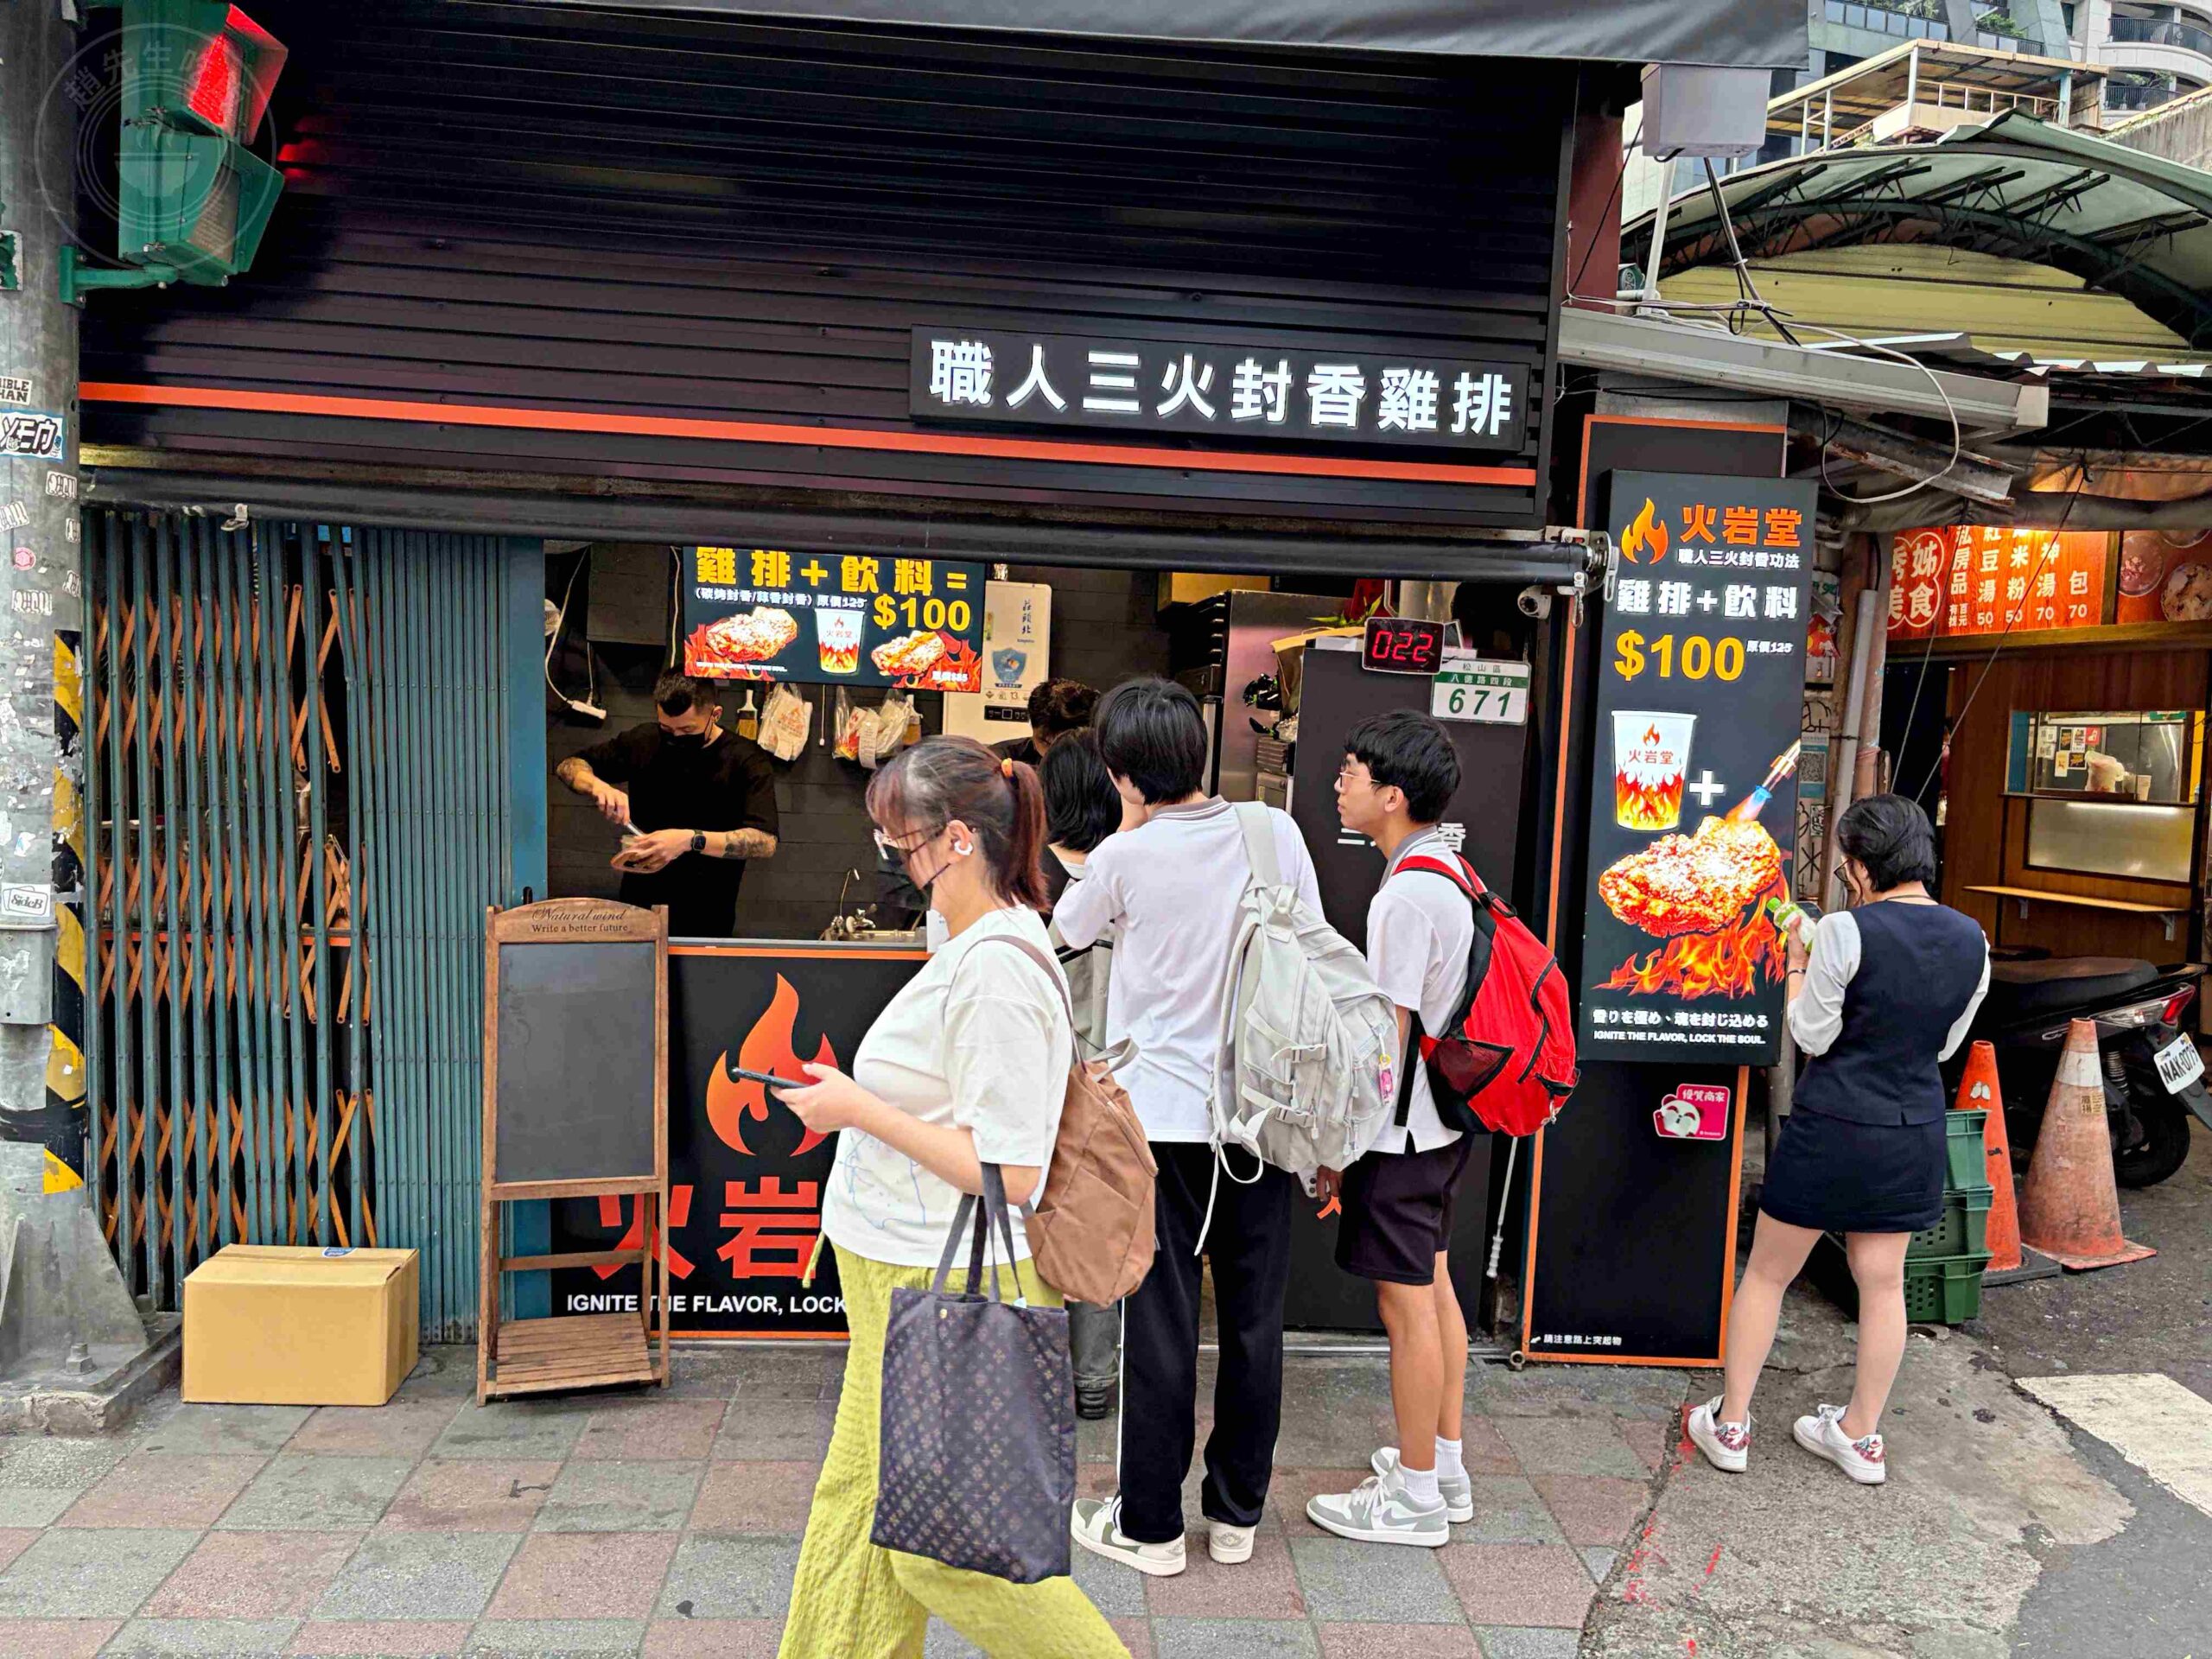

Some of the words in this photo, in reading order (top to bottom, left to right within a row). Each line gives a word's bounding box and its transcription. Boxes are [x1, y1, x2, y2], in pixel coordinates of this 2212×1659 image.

[929, 340, 1513, 435] 職人三火封香雞排
[1680, 504, 1802, 547] 火岩堂
[873, 593, 971, 632] $100
[1977, 611, 1993, 626] 50
[2005, 609, 2023, 623] 50
[2036, 606, 2055, 621] 70
[2069, 604, 2088, 620] 70
[1372, 629, 1433, 663] 022
[1614, 629, 1745, 682] $100
[1451, 673, 1513, 687] 八德路四段
[1448, 688, 1511, 717] 671
[1628, 748, 1674, 765] 火岩堂
[593, 909, 626, 921] wind
[531, 924, 558, 933] Write
[569, 923, 597, 932] better
[600, 923, 628, 932] future
[1593, 1030, 1626, 1040] IGNITE
[1627, 1032, 1646, 1041] THE
[1648, 1033, 1688, 1044] FLAVOR,
[1689, 1034, 1716, 1043] LOCK
[1716, 1035, 1736, 1044] THE
[1737, 1035, 1766, 1045] SOUL.
[1682, 1089, 1726, 1103] 優質商家
[567, 1294, 638, 1312] IGNITE
[693, 1294, 783, 1316] FLAVOR,
[790, 1296, 846, 1313] LOCK
[1543, 1334, 1622, 1347] 請注意路上突起物
